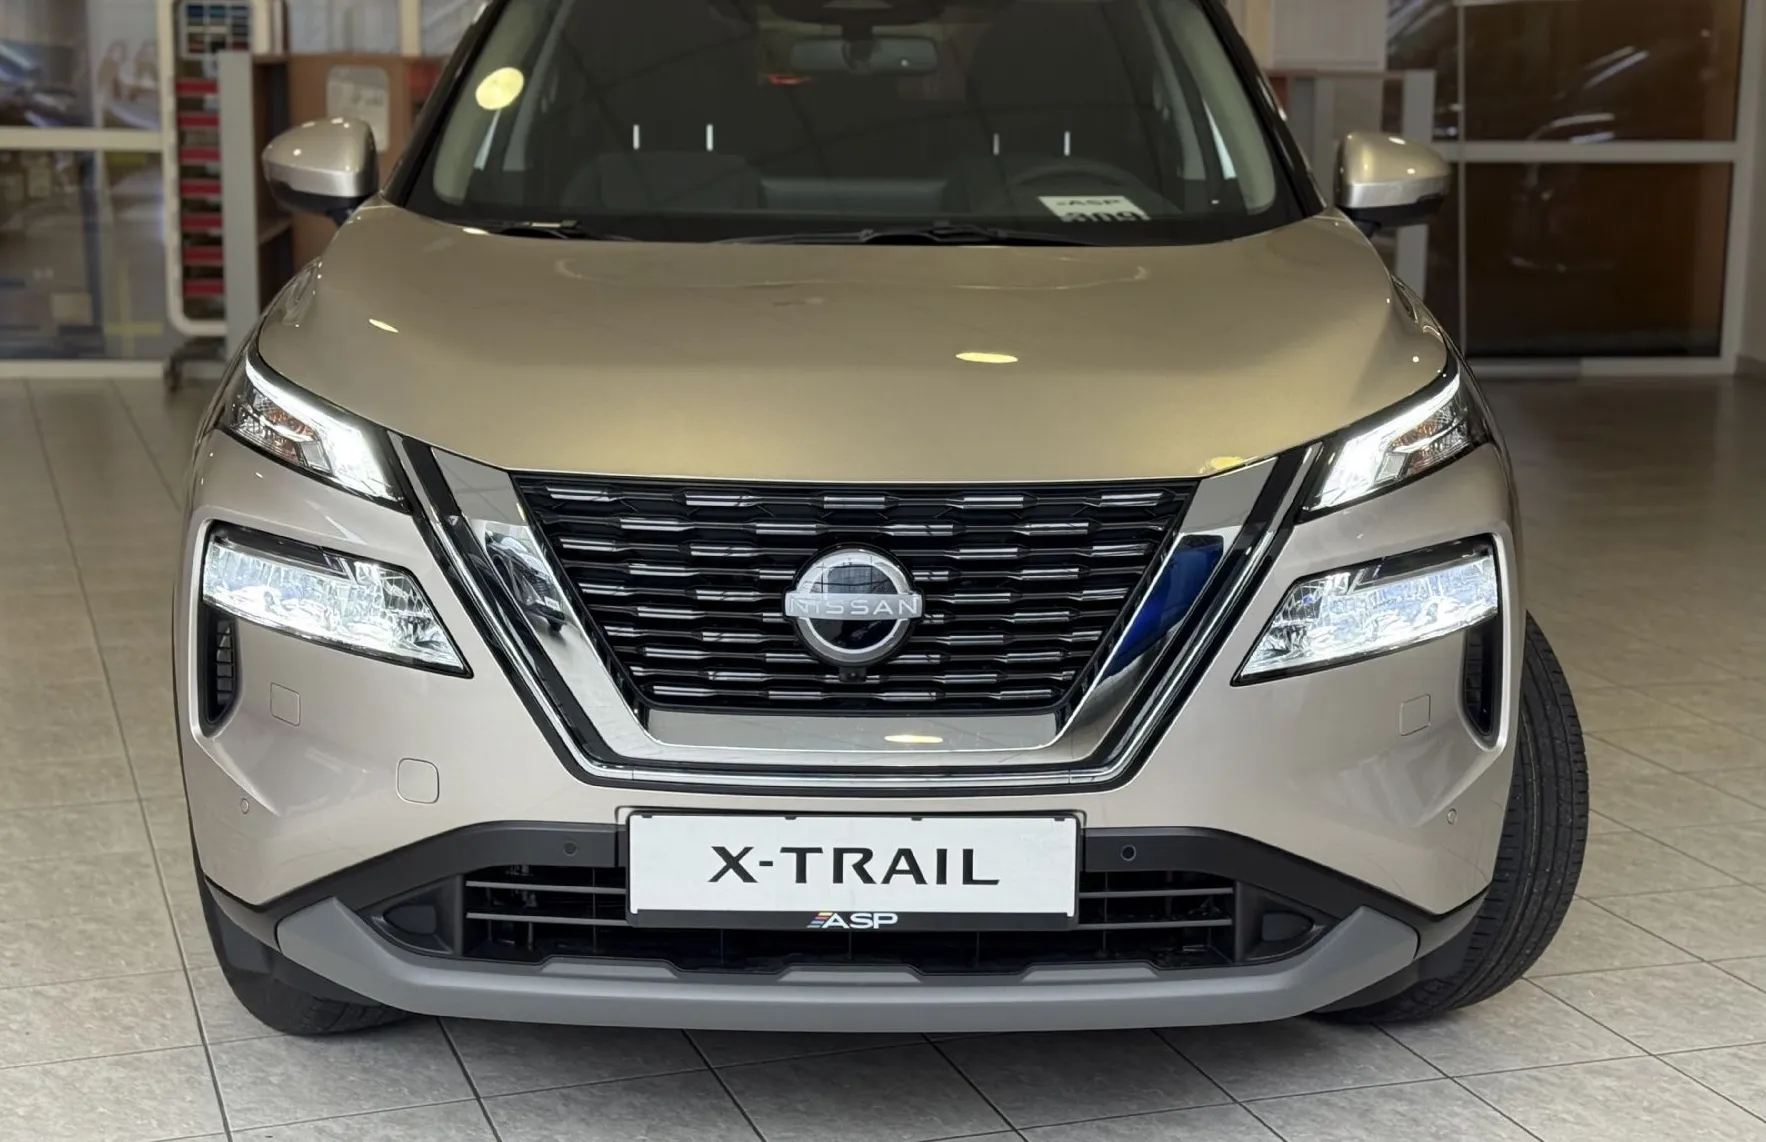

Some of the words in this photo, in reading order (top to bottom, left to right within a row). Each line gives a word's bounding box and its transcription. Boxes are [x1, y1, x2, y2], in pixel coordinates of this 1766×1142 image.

[789, 596, 919, 616] NISSAN
[708, 846, 1000, 886] X-TRAIL
[821, 912, 899, 929] ASP
